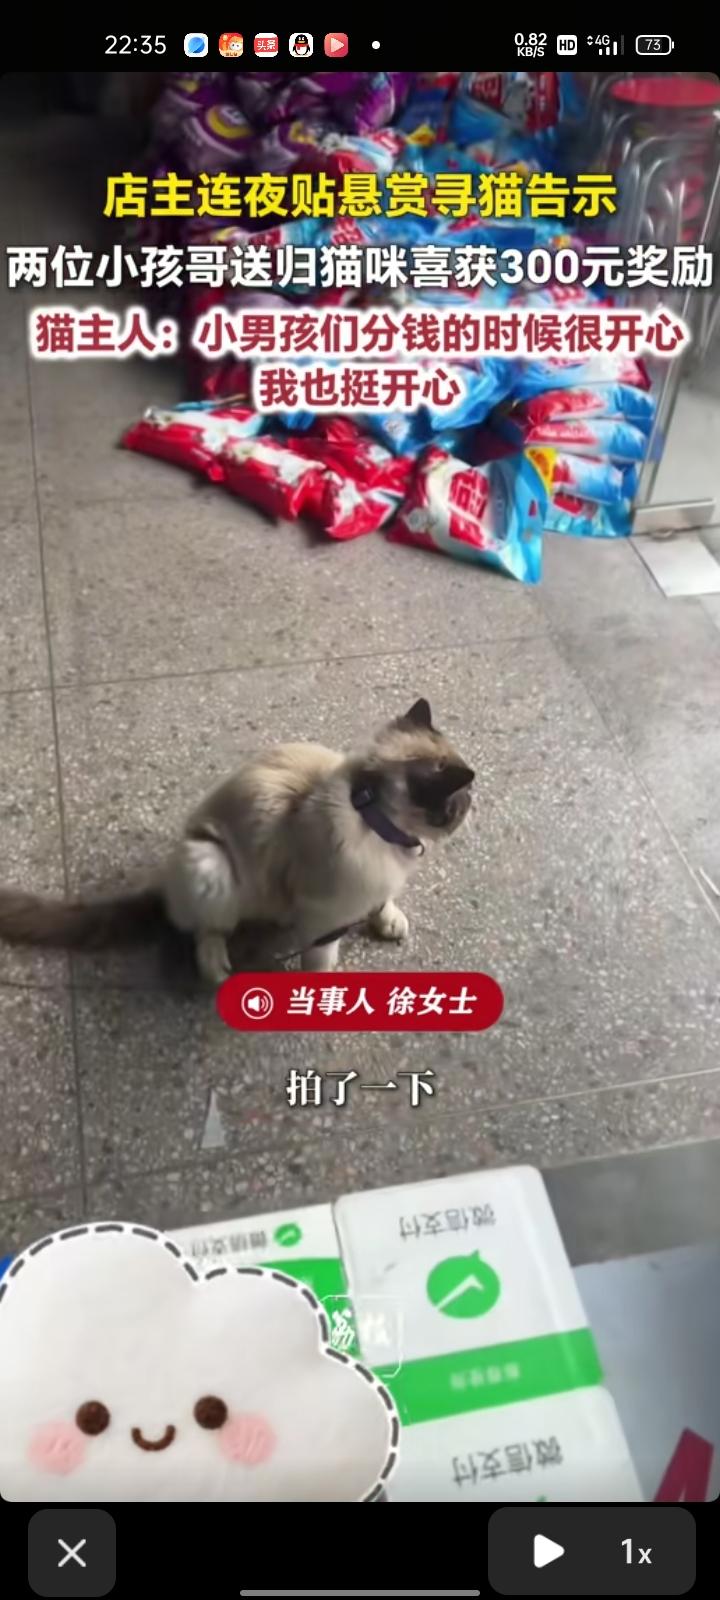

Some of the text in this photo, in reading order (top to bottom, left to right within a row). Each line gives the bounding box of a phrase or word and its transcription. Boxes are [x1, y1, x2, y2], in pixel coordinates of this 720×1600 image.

[400, 1204, 496, 1241] 微信支付
[451, 1436, 563, 1487] 微信支付
